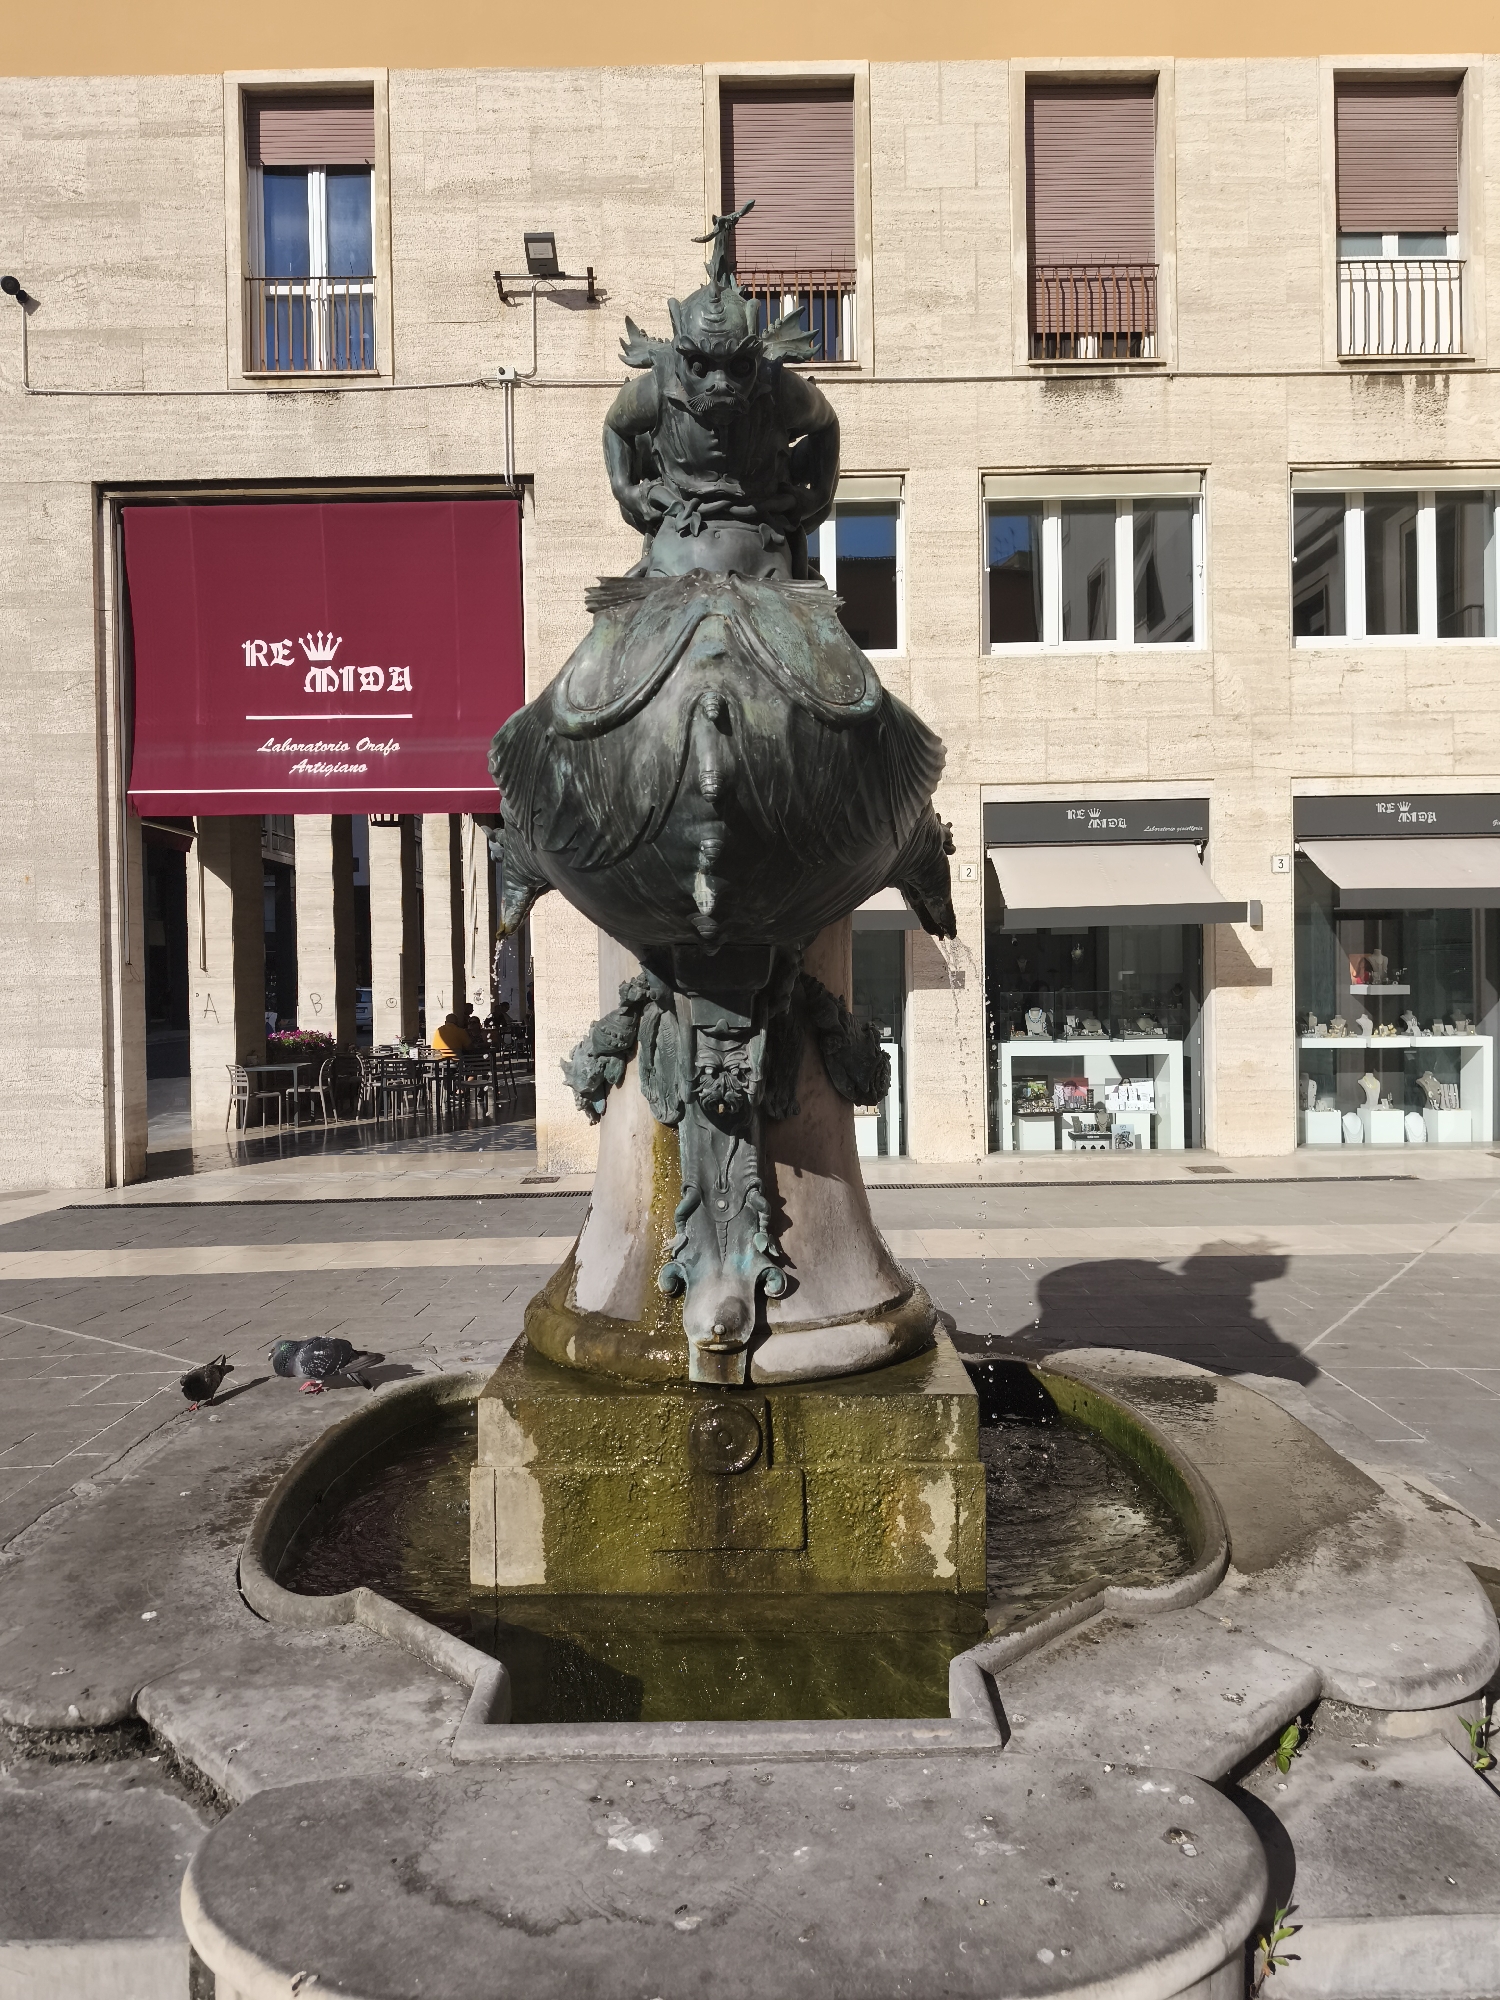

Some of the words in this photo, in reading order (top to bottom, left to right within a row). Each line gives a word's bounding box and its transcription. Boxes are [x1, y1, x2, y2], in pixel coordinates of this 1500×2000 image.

[241, 638, 295, 667] RE
[303, 665, 413, 693] MIDA
[256, 737, 351, 753] Laboratorio
[355, 736, 401, 757] Orafo
[288, 758, 368, 777] Artigiano
[1065, 808, 1086, 820] RE
[1375, 802, 1396, 814] RE
[1087, 817, 1127, 829] MIDA
[1397, 811, 1437, 824] MIDA
[1278, 858, 1284, 869] 3
[966, 867, 972, 878] 2
[203, 992, 220, 1024] A
[309, 992, 323, 1017] B
